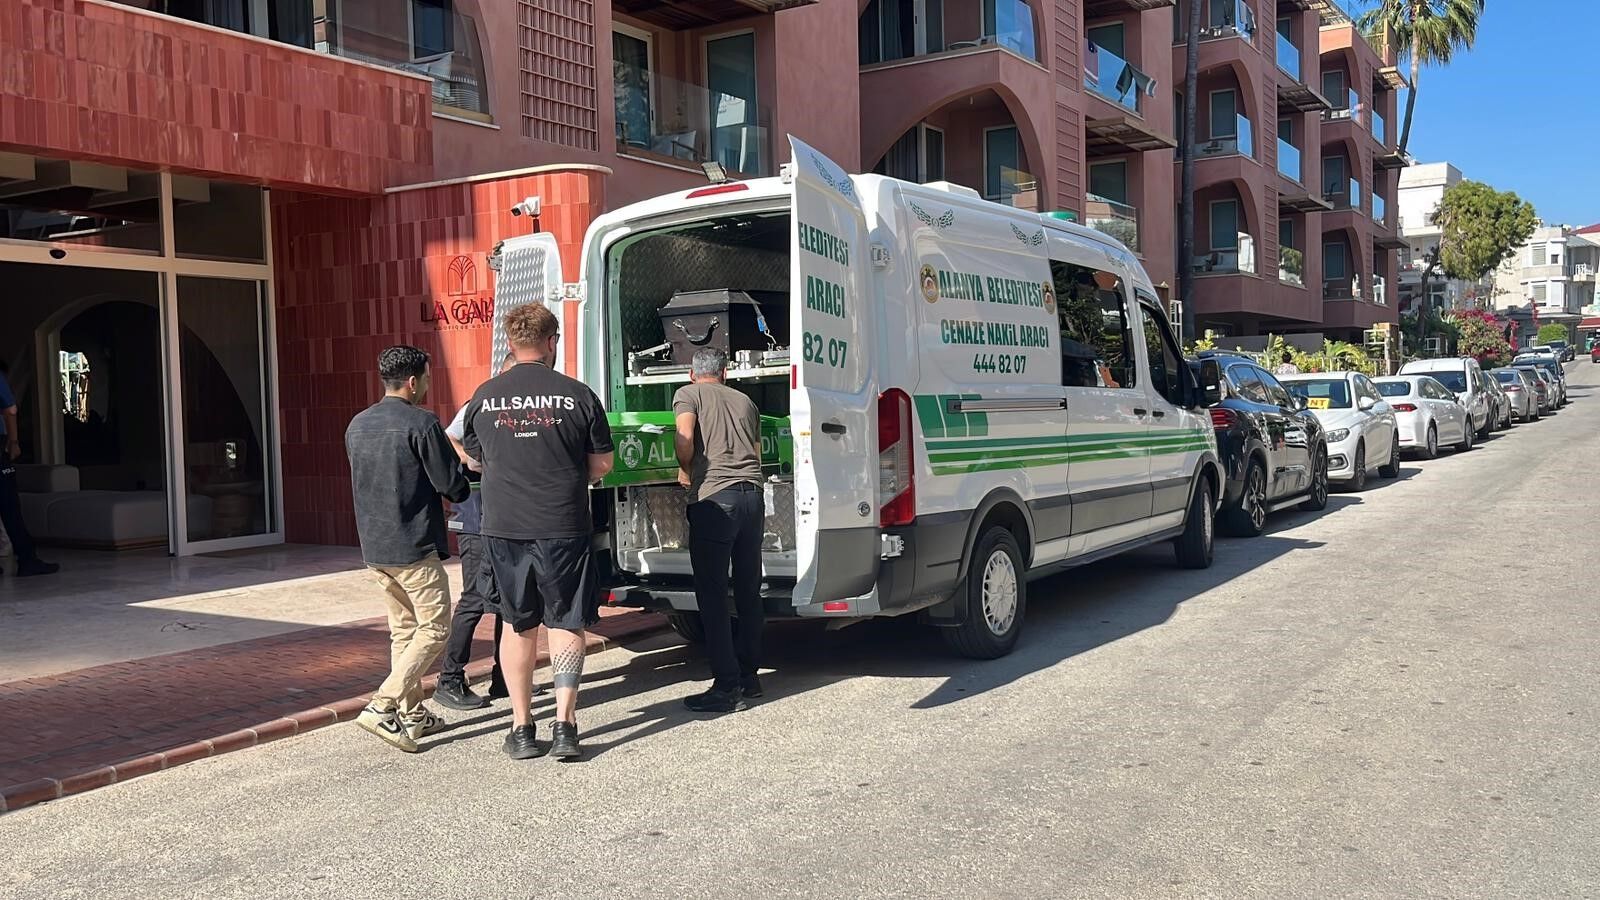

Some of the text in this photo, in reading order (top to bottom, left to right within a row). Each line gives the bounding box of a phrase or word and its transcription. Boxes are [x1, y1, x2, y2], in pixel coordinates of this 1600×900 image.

[806, 275, 846, 319] ARACI
[938, 270, 1043, 308] ALANYA BELEDİYESİ
[803, 331, 847, 369] 82 07
[940, 319, 1049, 348] CENAZE NAKİL ARACI
[973, 353, 1026, 374] 444 82 07
[481, 395, 575, 413] ALLSAINTS
